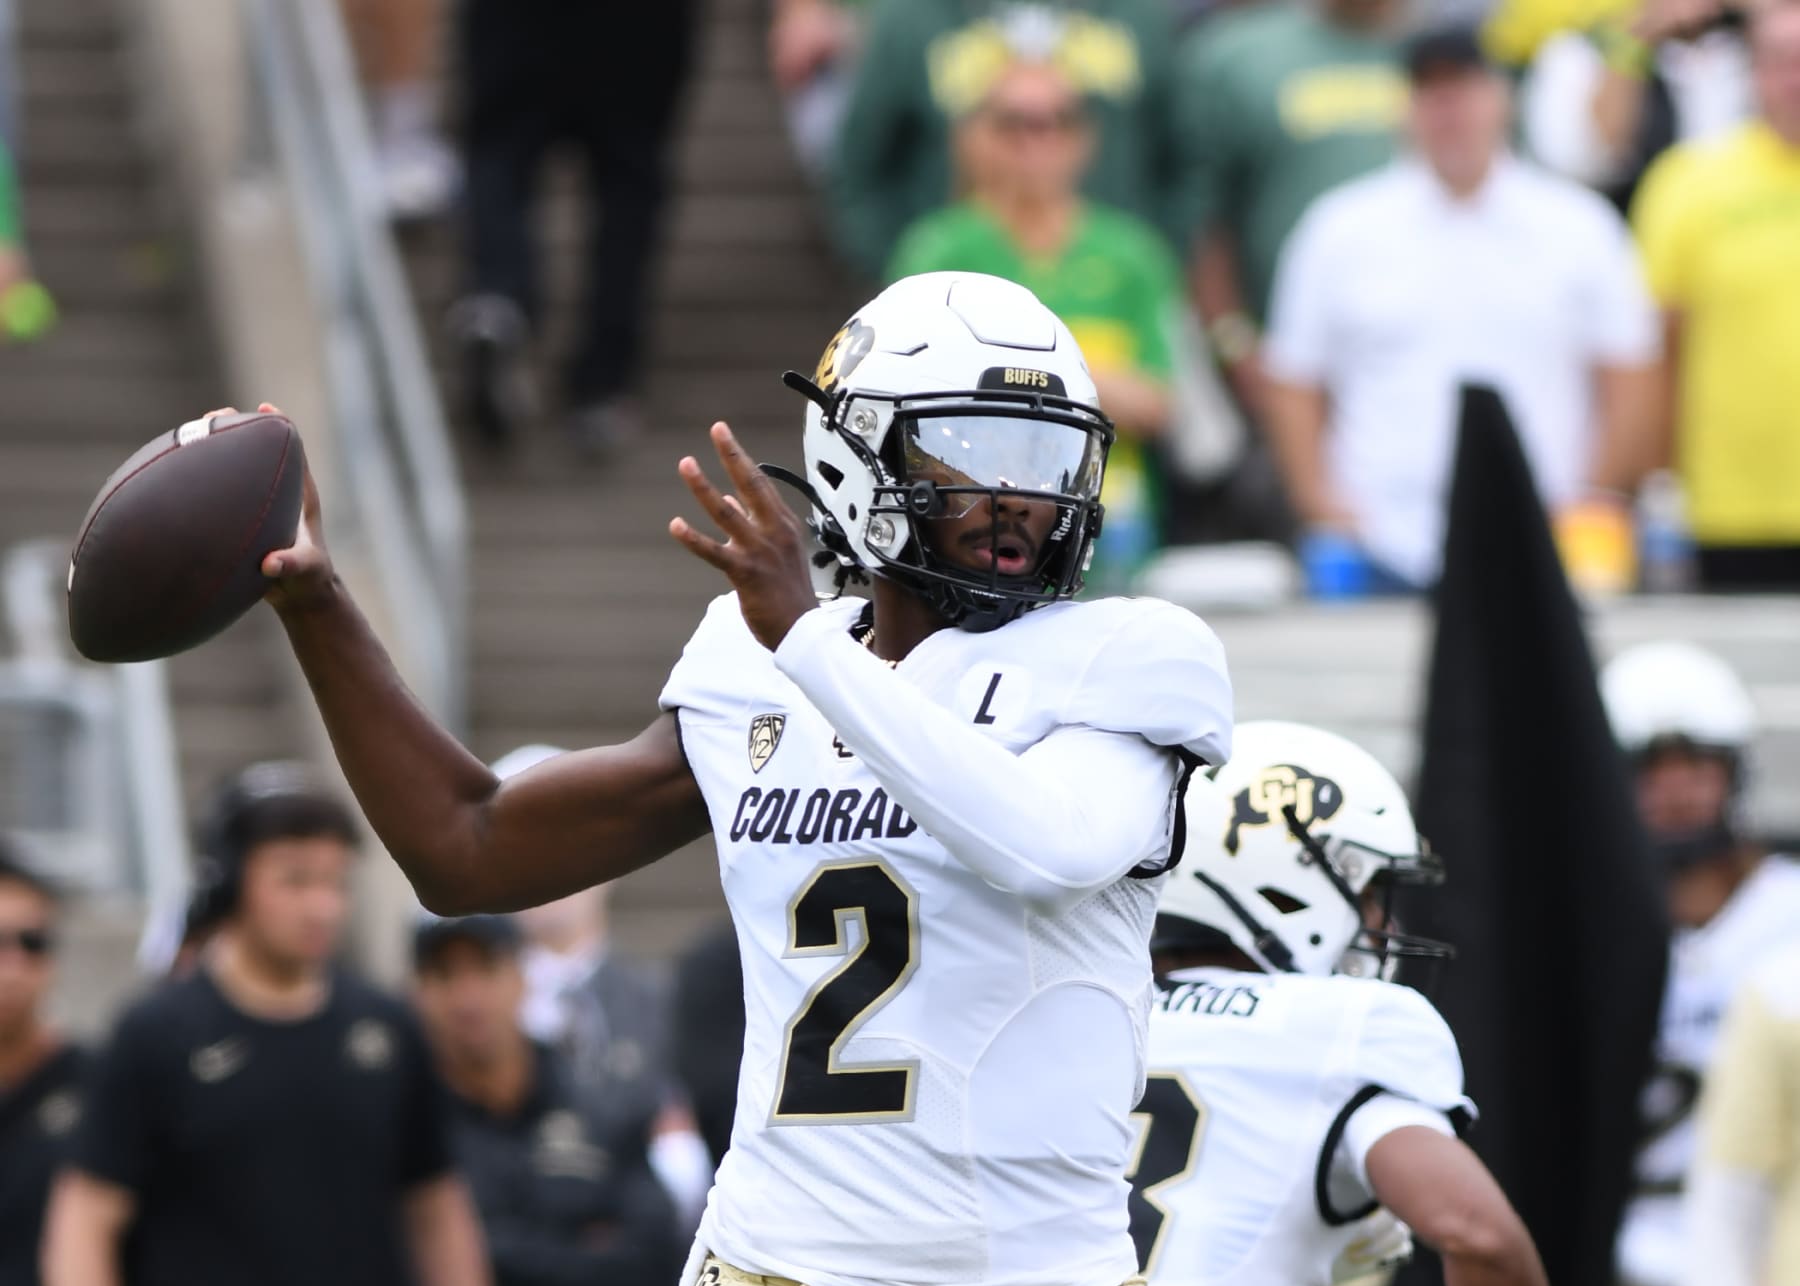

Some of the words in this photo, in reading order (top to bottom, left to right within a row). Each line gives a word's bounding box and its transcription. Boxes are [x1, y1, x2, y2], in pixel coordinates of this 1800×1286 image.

[1004, 367, 1049, 388] BUFFS
[973, 672, 1003, 725] L
[750, 716, 784, 748] PAC
[752, 738, 770, 760] 12
[729, 786, 932, 845] COLORAD
[766, 854, 922, 1129] 2
